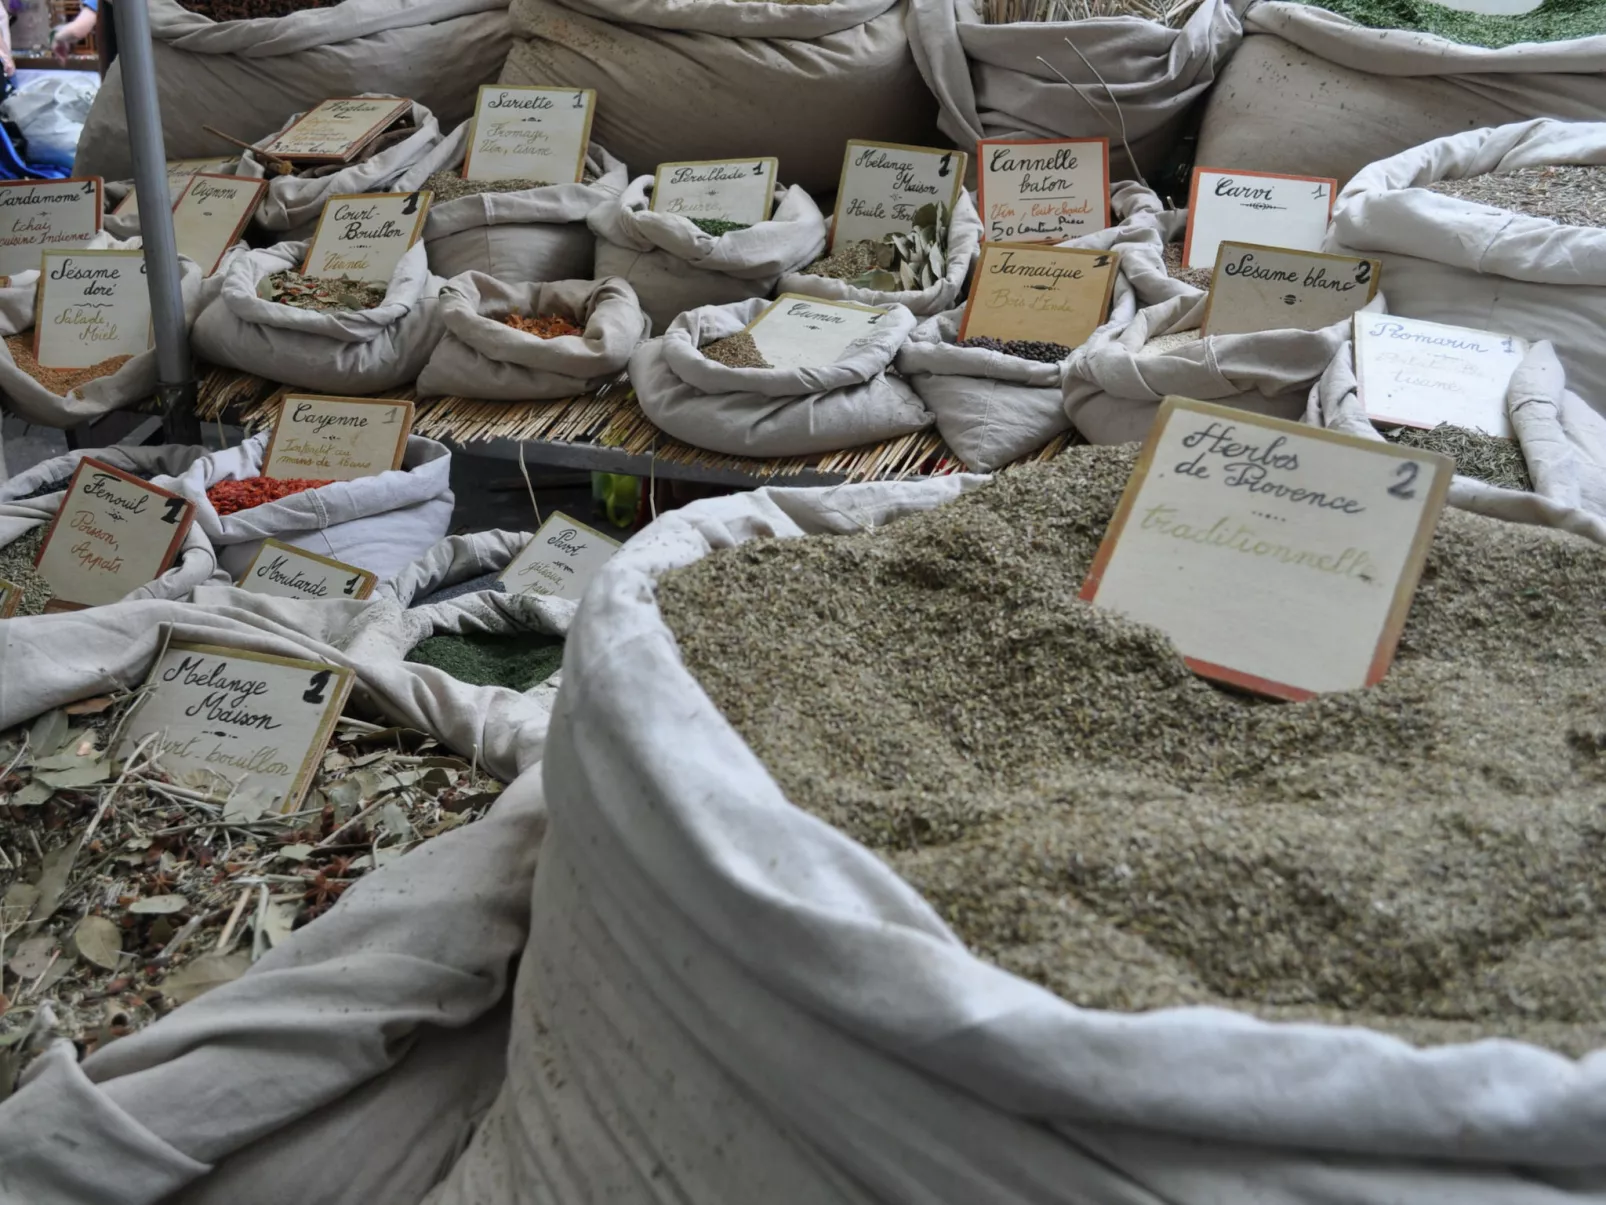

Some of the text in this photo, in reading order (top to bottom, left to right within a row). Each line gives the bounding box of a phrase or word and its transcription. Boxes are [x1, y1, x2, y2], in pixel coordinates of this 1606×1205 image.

[488, 90, 583, 109] Sariette 1
[753, 161, 764, 175] 1
[856, 149, 914, 180] Mélange
[990, 149, 1078, 172] Cannelle
[0, 180, 94, 206] Cardamome 1
[191, 180, 237, 204] Oignons
[893, 173, 938, 194] Maison
[1215, 177, 1327, 200] Carvi 1
[402, 192, 419, 215] 1
[847, 199, 917, 221] Huile Fort
[37, 233, 90, 244] Indienne
[339, 220, 404, 240] Bouillon
[992, 221, 1014, 240] 50
[51, 258, 121, 280] Sésame
[990, 252, 1084, 286] Jamaïque
[1225, 253, 1371, 291] Sésame blanc 2
[84, 280, 117, 296] doré
[787, 302, 846, 324] Cumin
[1369, 322, 1515, 353] Romarin 1
[292, 403, 398, 433] Cayenne 1
[316, 456, 331, 467] de
[1182, 423, 1419, 500] Herbes 2
[83, 473, 149, 514] Fenouil
[1174, 453, 1366, 514] de Provence
[547, 529, 588, 556] Pavot
[1140, 504, 1377, 580] traditionnelle
[257, 555, 361, 597] Moutarde 1
[163, 656, 268, 708] Mélange
[185, 691, 282, 730] Maison
